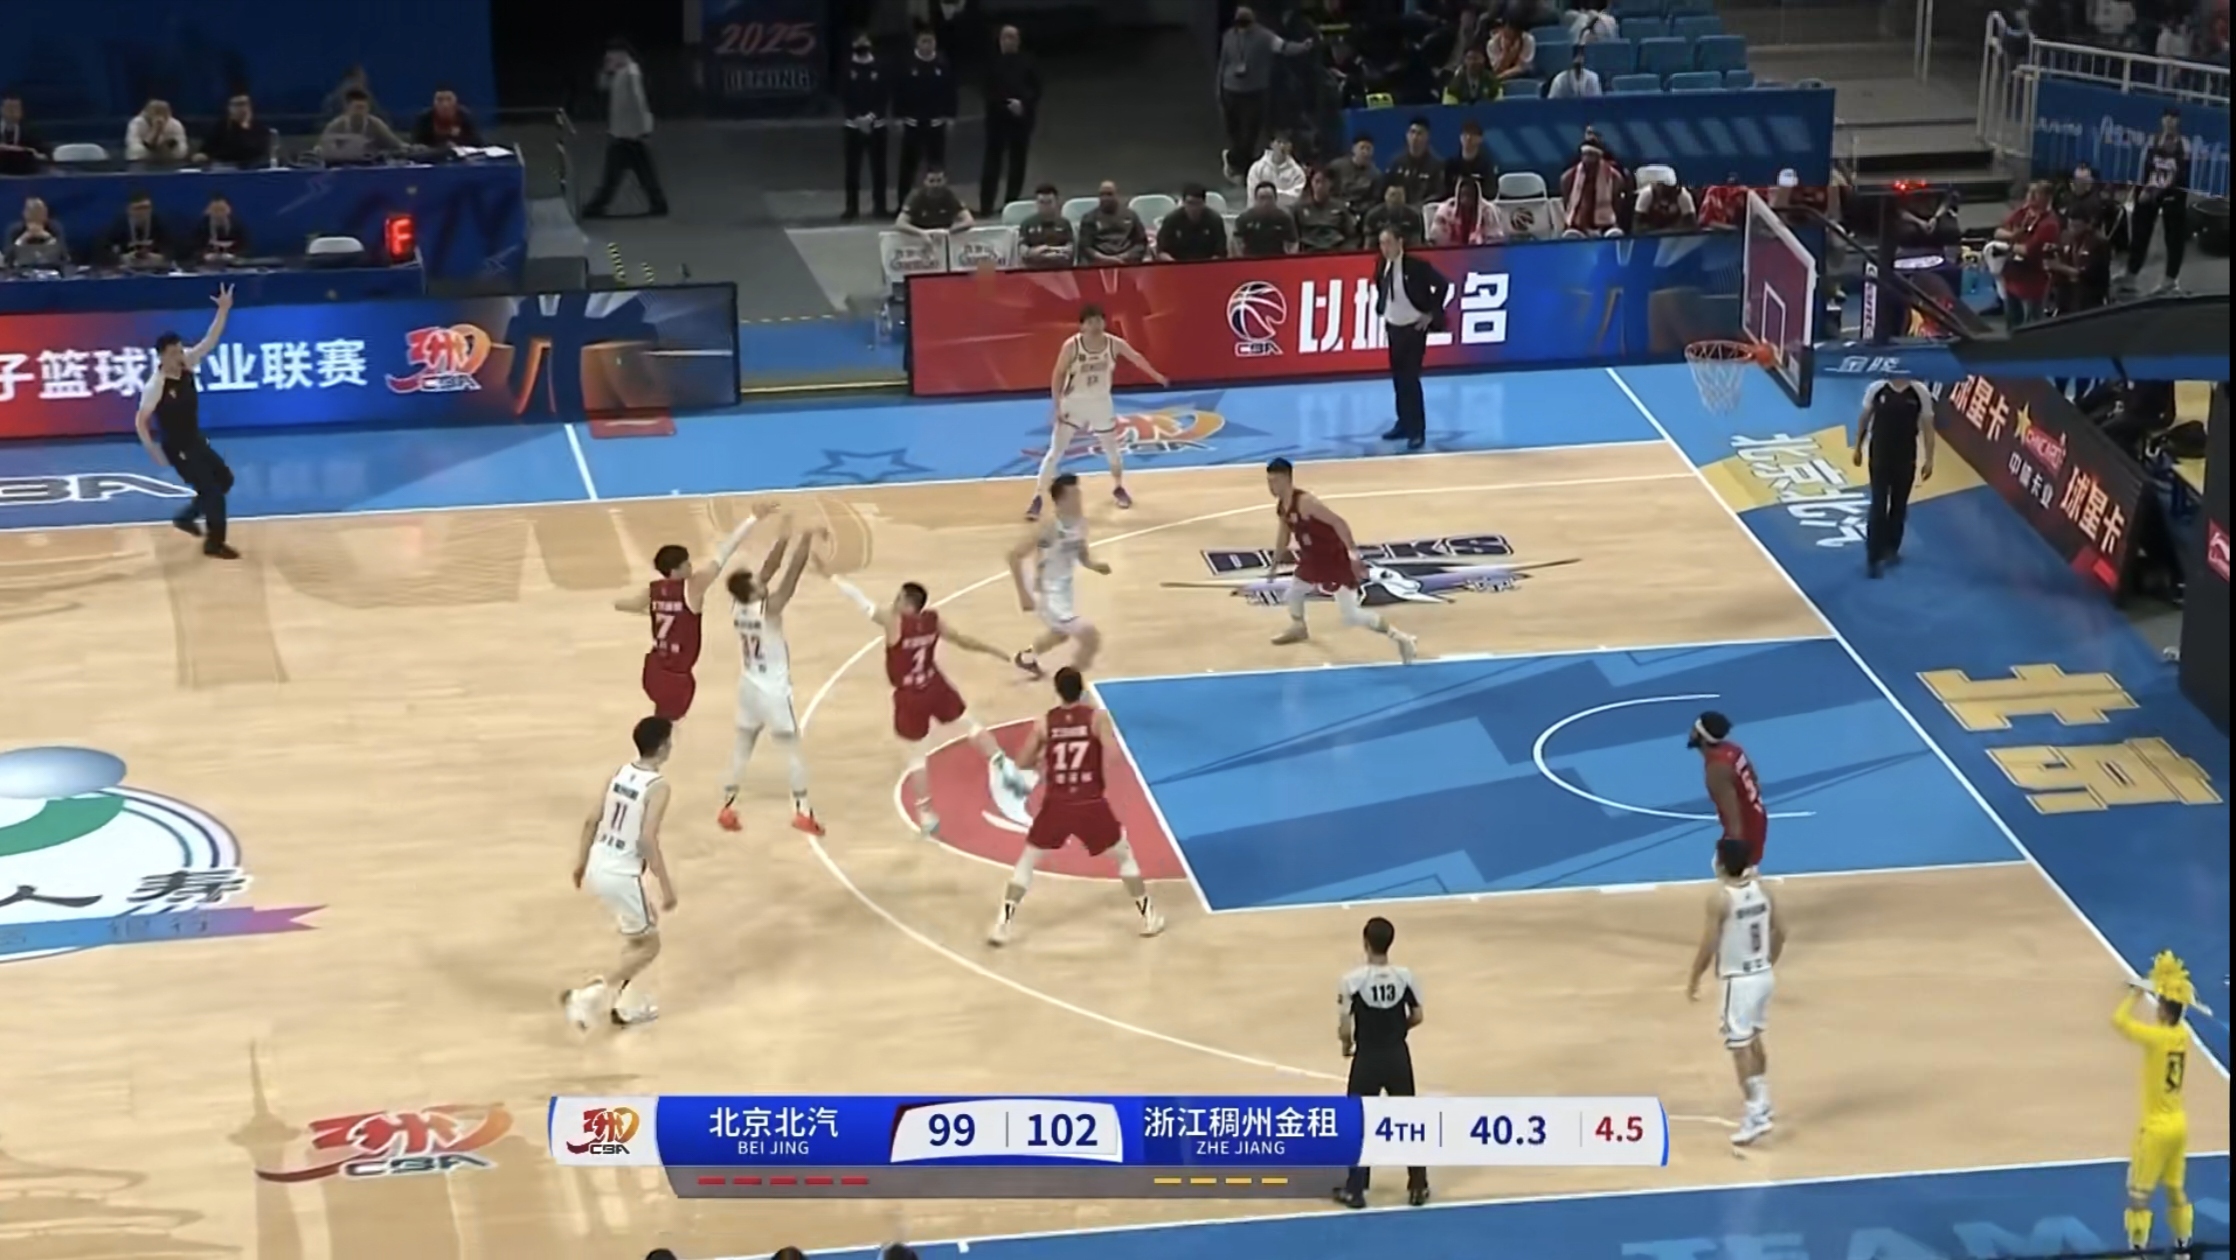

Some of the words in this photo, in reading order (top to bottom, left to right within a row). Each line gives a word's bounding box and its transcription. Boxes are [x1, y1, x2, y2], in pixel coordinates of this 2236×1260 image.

[1234, 341, 1284, 357] CBA
[0, 338, 368, 401] 子篮球业联赛
[2059, 466, 2126, 555] 球星卡
[653, 613, 676, 640] 7
[1052, 741, 1090, 772] 17
[610, 801, 628, 832] 11
[1371, 983, 1397, 1003] 113
[343, 1151, 496, 1178] CBA
